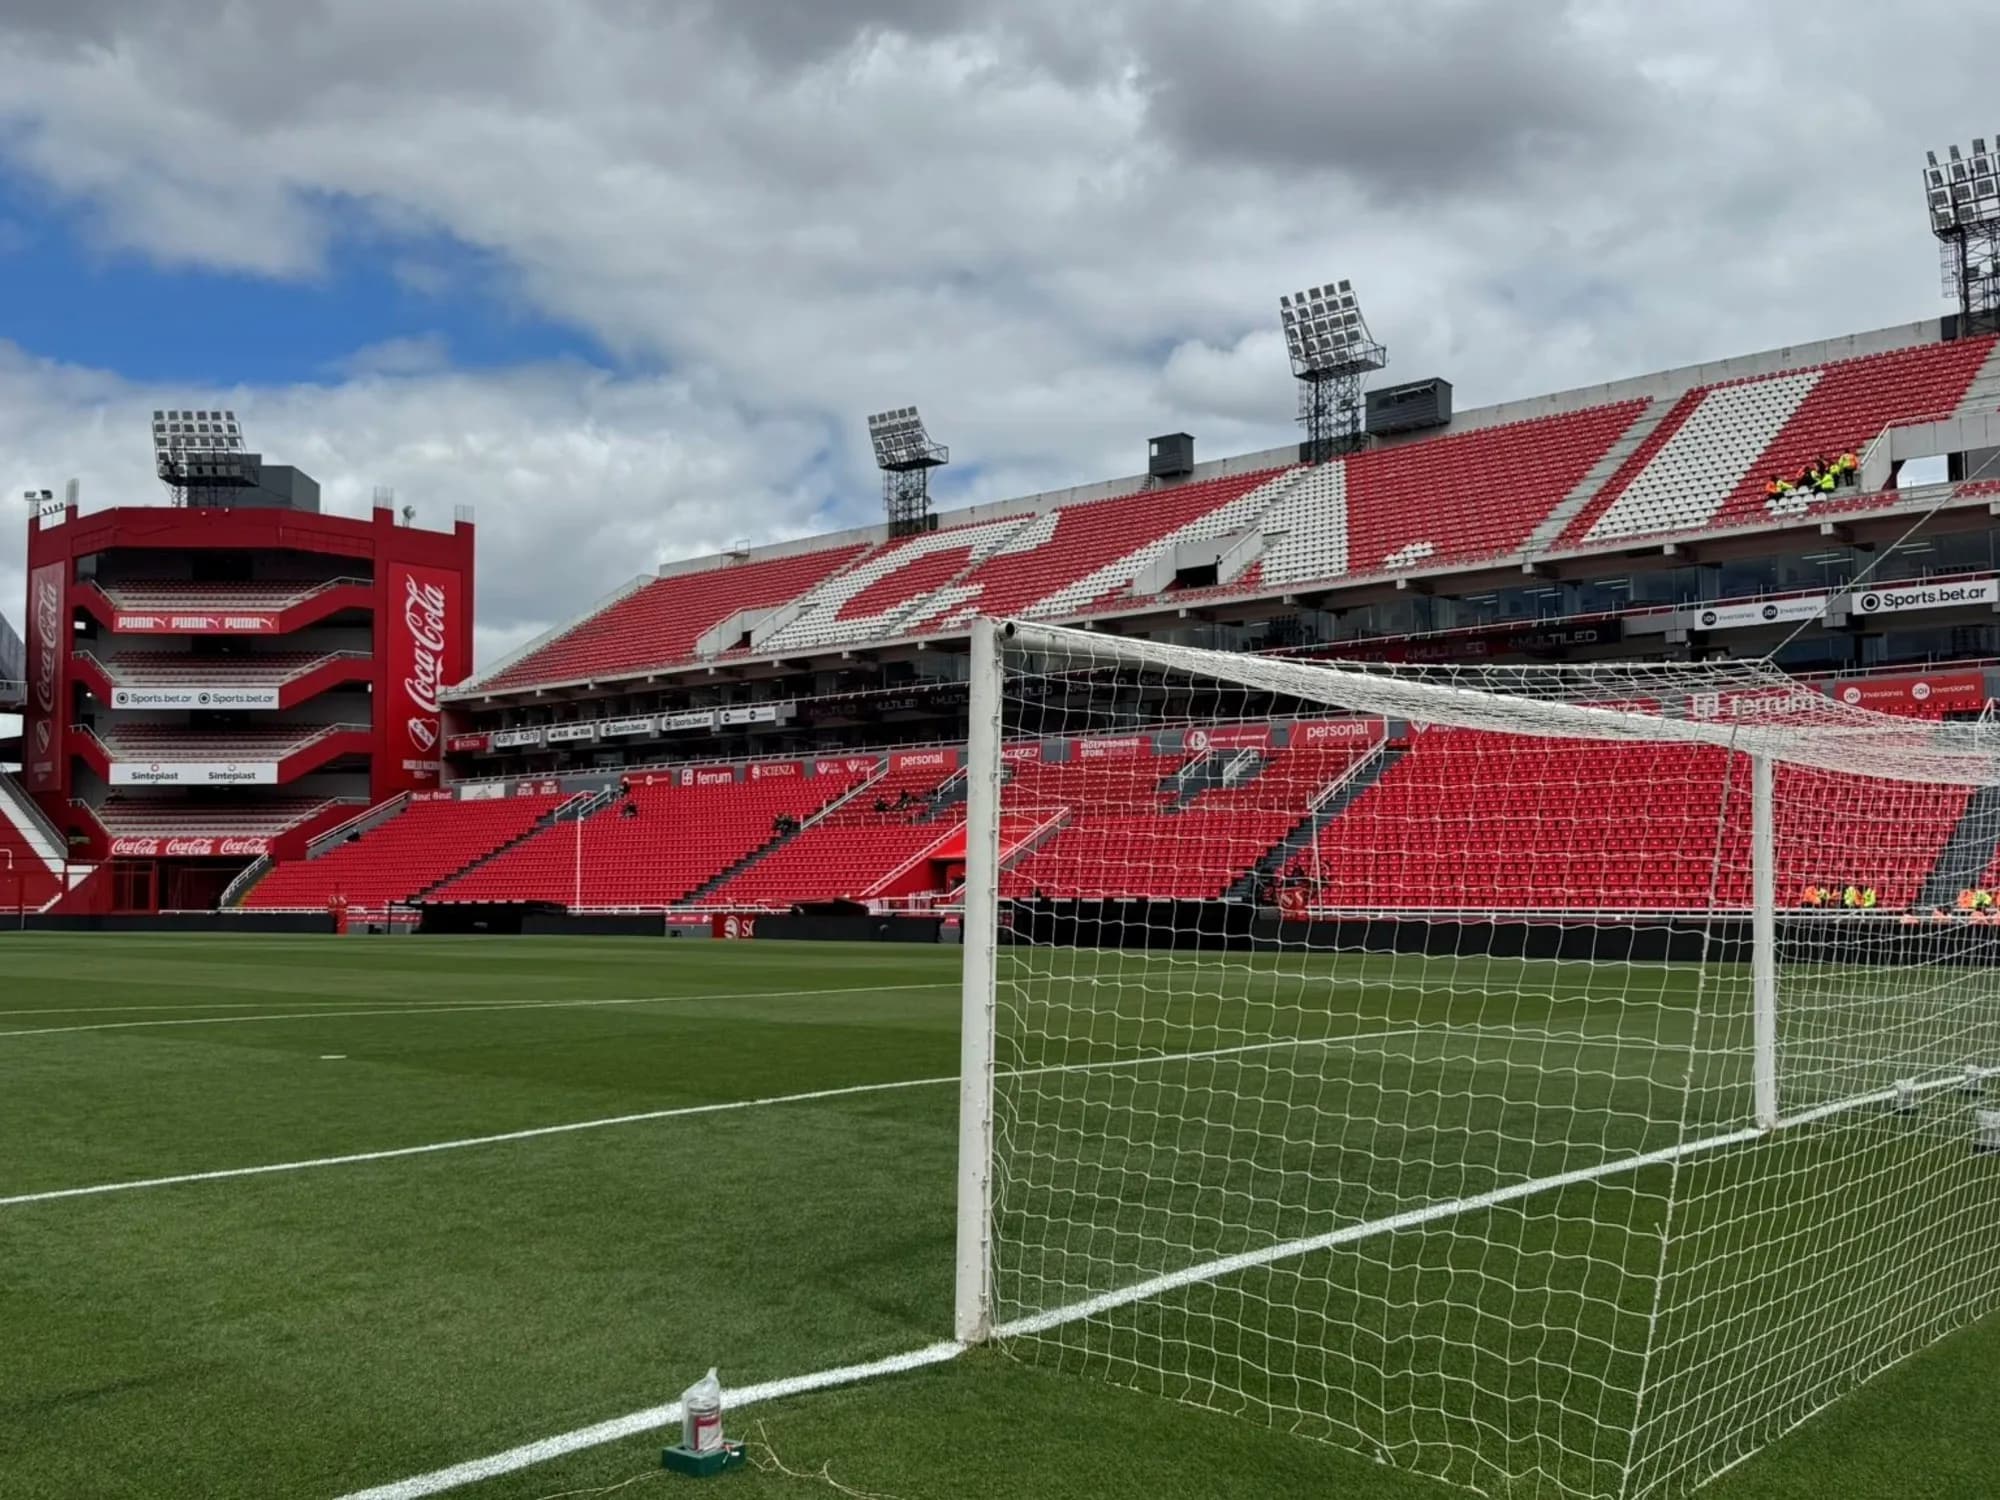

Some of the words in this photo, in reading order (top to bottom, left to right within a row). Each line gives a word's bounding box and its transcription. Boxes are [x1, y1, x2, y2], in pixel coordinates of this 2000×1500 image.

[1884, 587, 1987, 609] Sports.bet.ar
[131, 693, 192, 704] Sports.bet.ar
[212, 693, 274, 704] Sports.bet.ar
[1307, 720, 1369, 741] personal
[900, 751, 944, 766] personal
[131, 771, 178, 781] Sinteplast
[208, 771, 256, 781] Sinteplast
[697, 771, 732, 785] ferrum
[761, 765, 796, 777] SCIENZA
